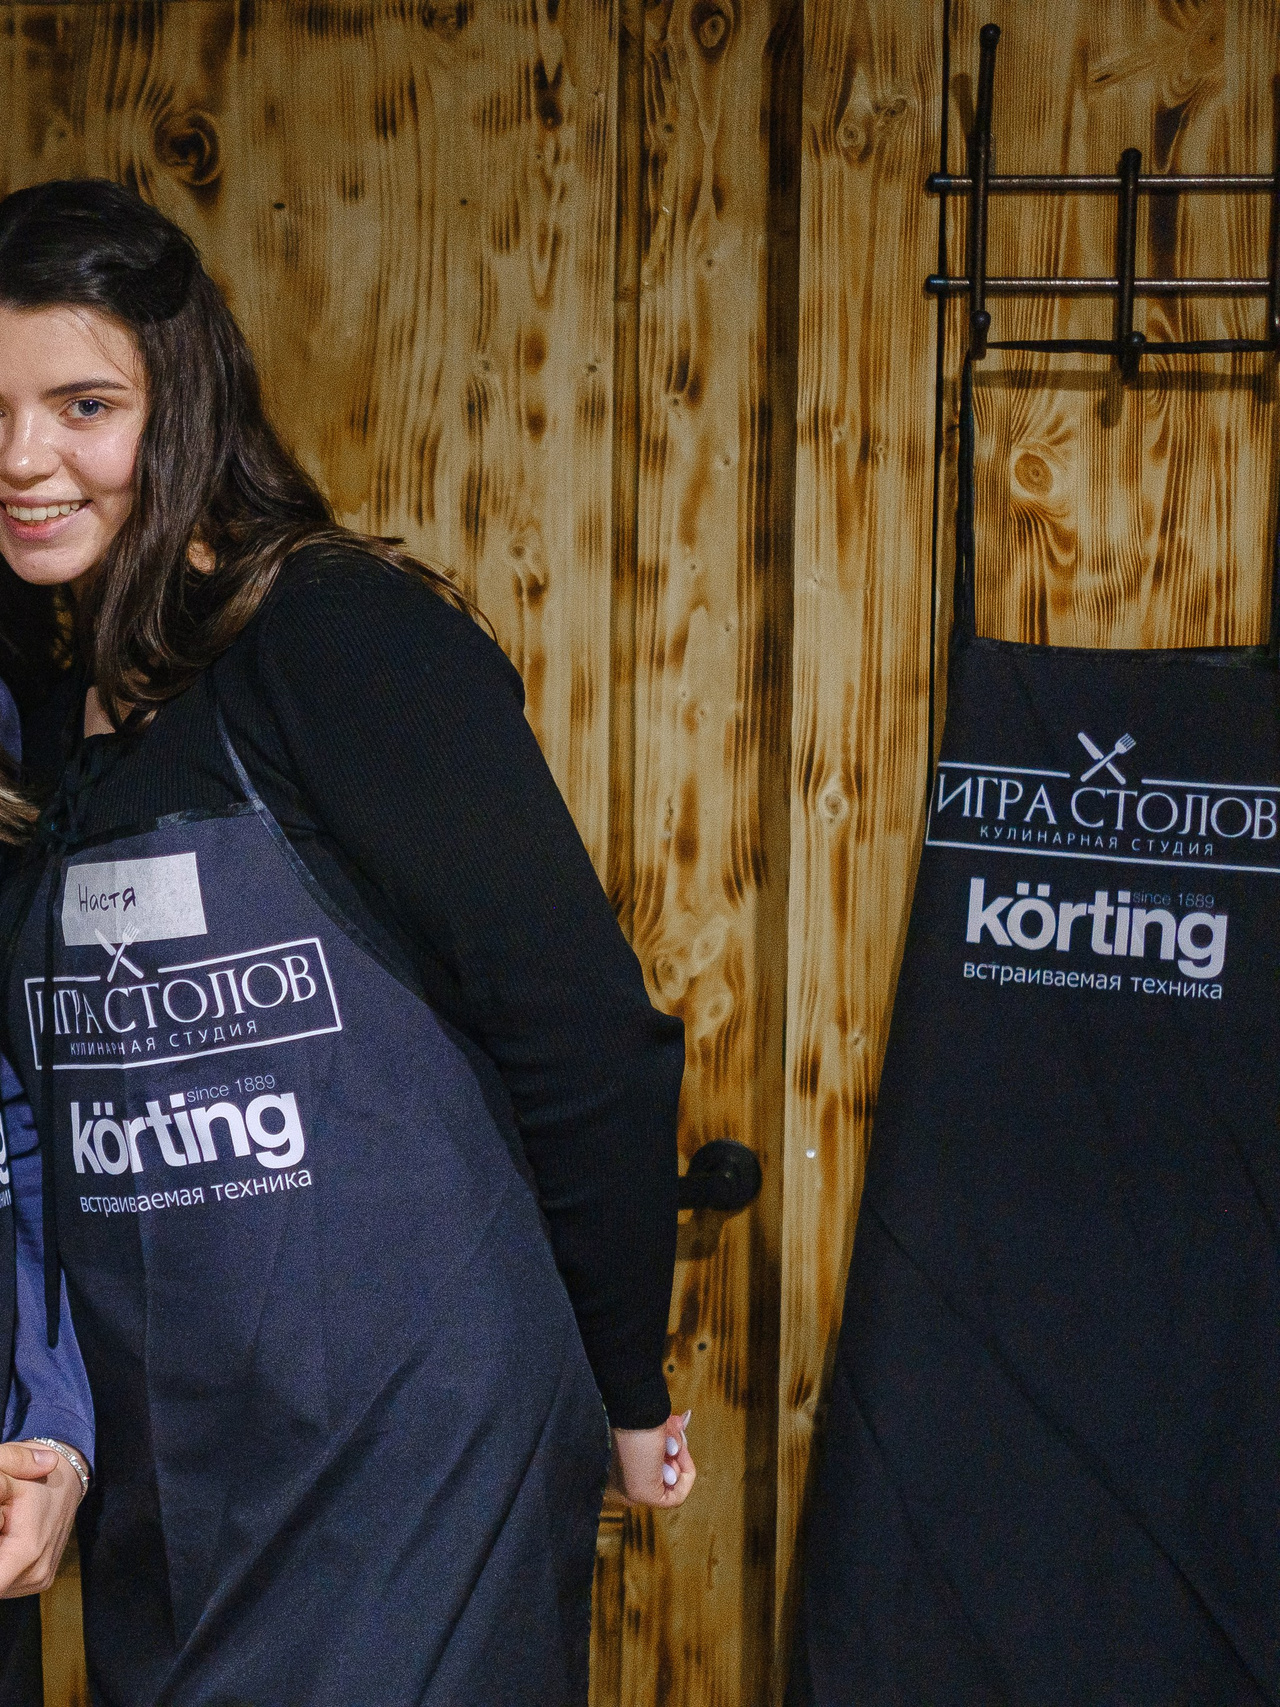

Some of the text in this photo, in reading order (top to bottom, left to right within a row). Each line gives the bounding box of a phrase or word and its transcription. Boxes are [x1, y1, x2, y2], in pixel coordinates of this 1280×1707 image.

[937, 773, 1277, 839] ИГРА СТОЛОВ
[979, 825, 1214, 857] КУЛИНАРНАЯ СТУДИЯ
[78, 883, 137, 913] Настя
[1132, 891, 1215, 909] since 1889
[966, 877, 1228, 979] körting
[105, 955, 317, 1034] СТОЛОВ
[963, 962, 1223, 1000] встраиваемая техника
[70, 1020, 258, 1055] КУЛИНАРНАЯ СТУДИЯ
[186, 1074, 276, 1103] since 1889
[70, 1091, 309, 1176] körting
[80, 1169, 313, 1218] встраиваемая техника
